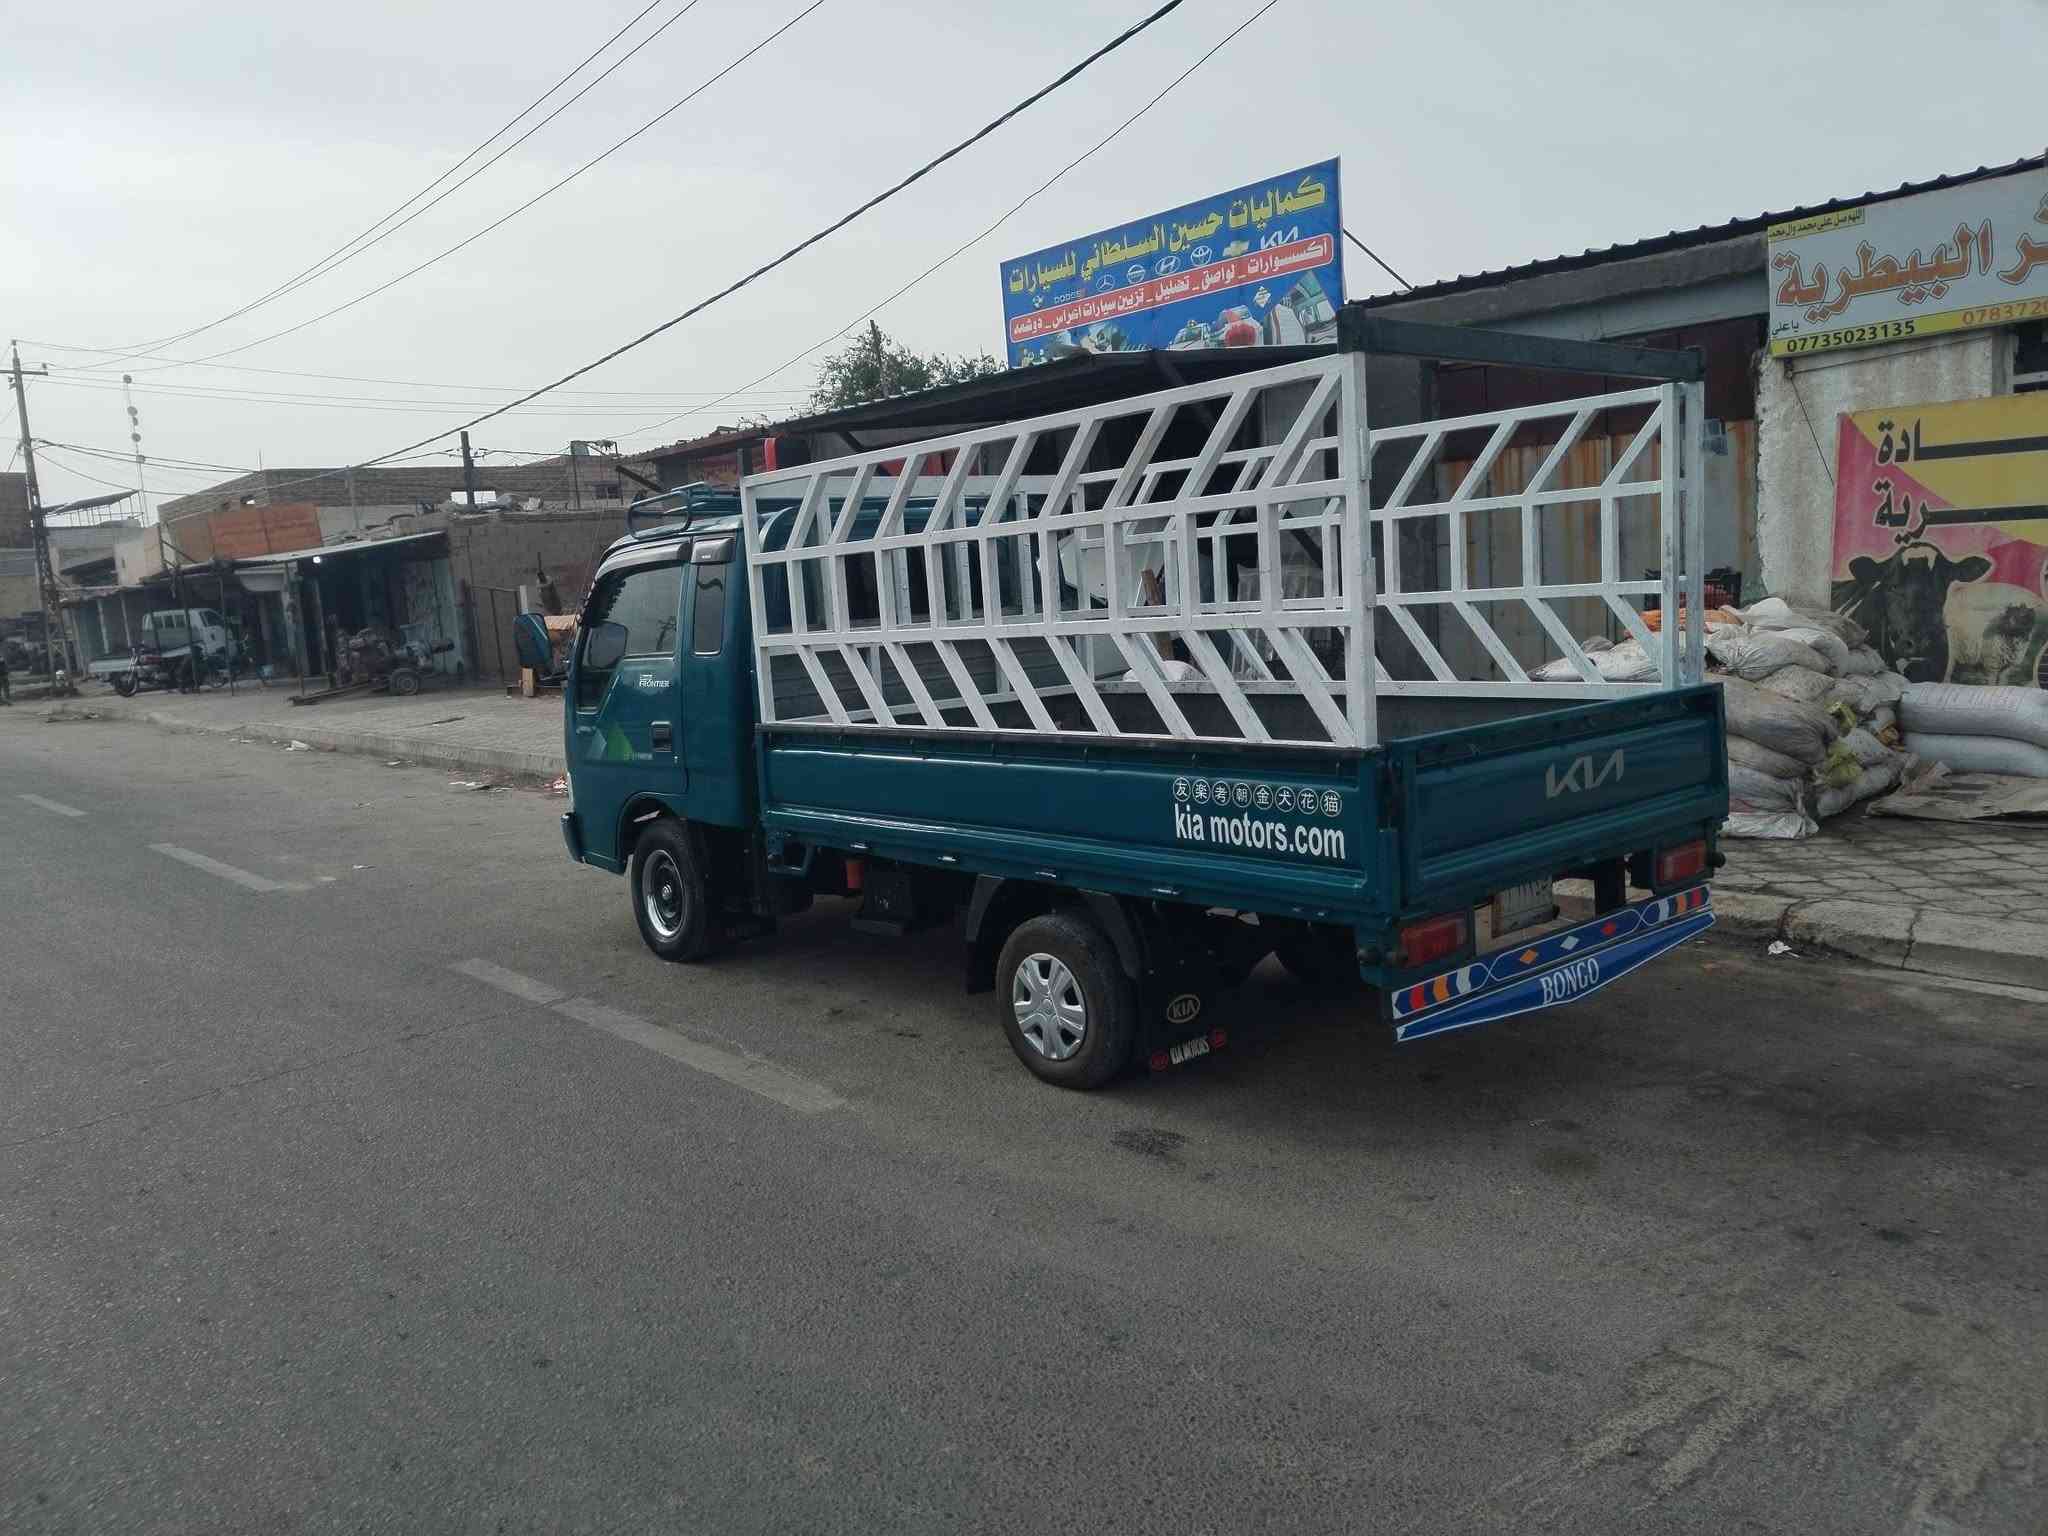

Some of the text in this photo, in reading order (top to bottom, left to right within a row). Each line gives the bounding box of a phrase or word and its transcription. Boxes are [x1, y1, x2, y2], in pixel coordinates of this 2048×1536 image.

[1009, 175, 1326, 295] كماليات حسين السلطاني للسيارات
[1771, 217, 1993, 324] البيطرية
[1786, 320, 1916, 353] 07735023135
[1545, 749, 1624, 800] KIA
[1174, 803, 1346, 860] kia motors.com
[1540, 957, 1600, 1006] BONGO
[1172, 999, 1198, 1018] KIA
